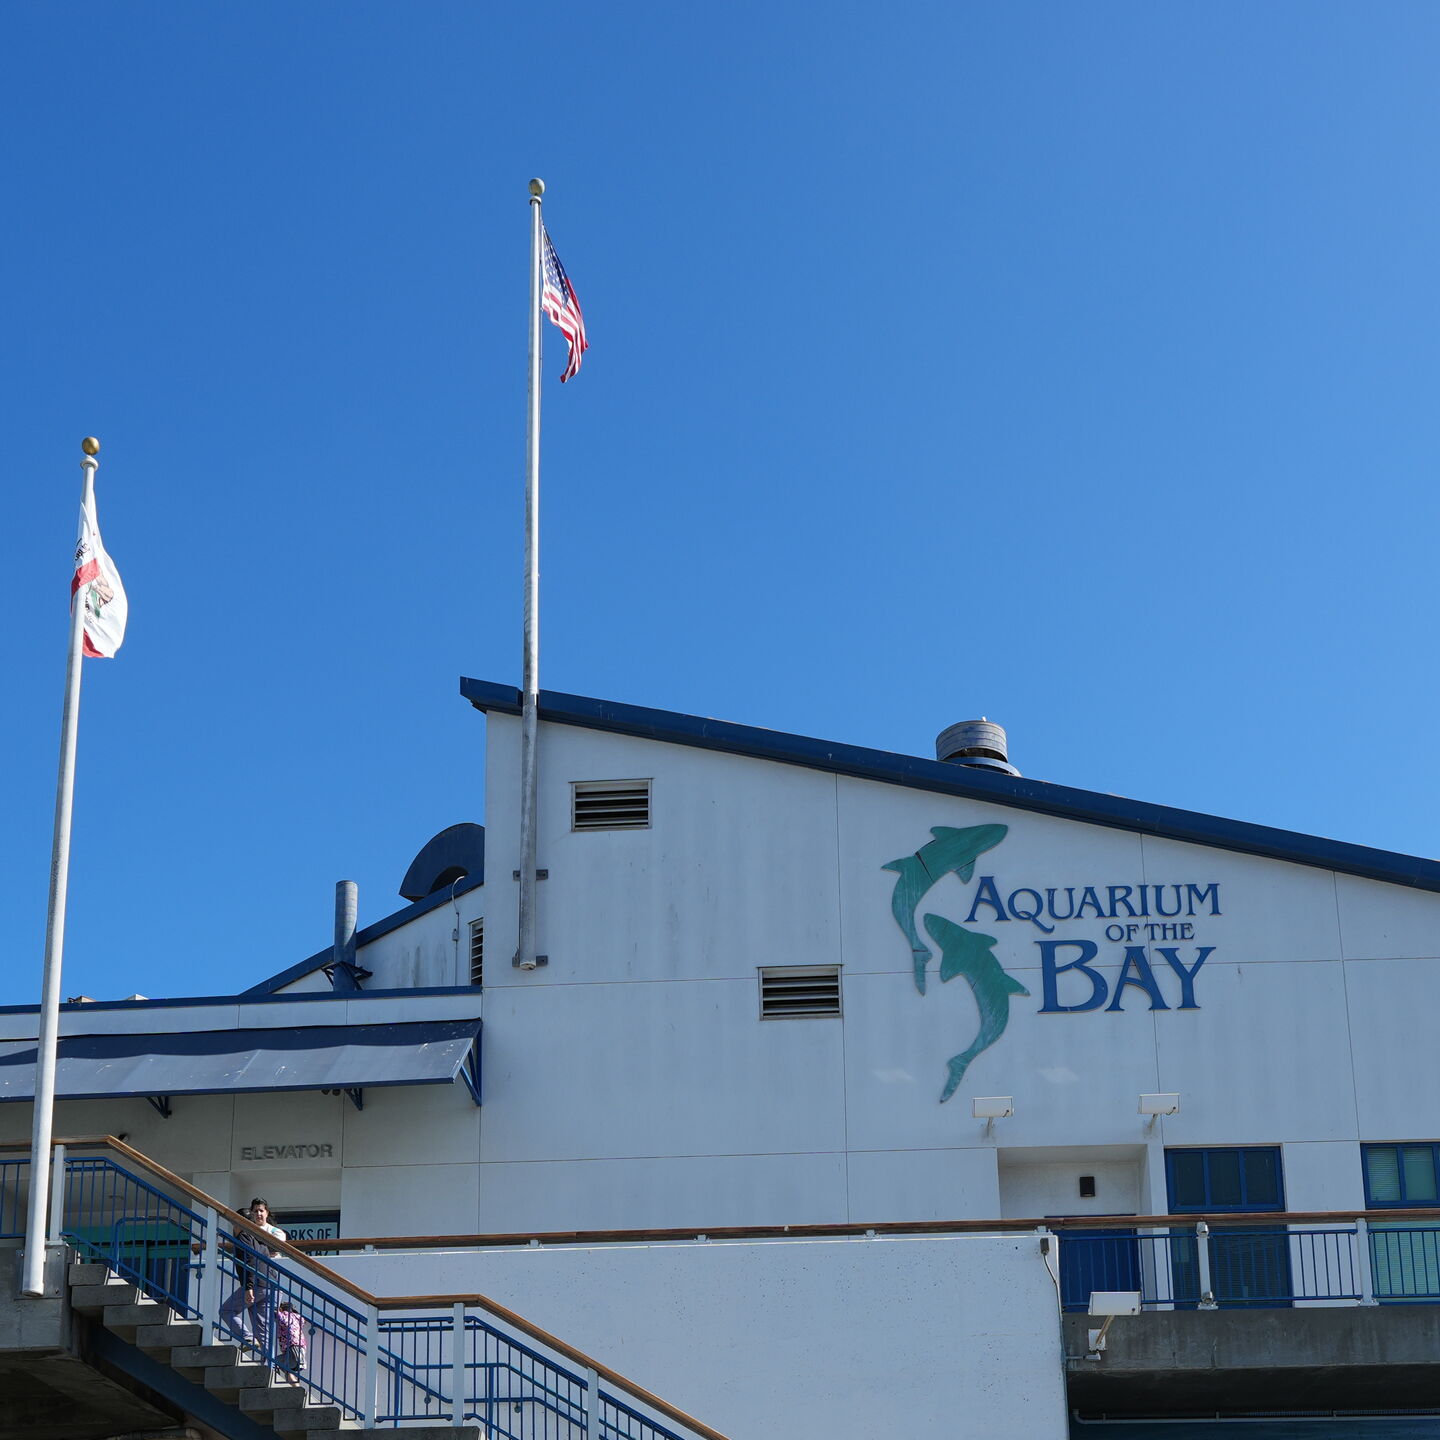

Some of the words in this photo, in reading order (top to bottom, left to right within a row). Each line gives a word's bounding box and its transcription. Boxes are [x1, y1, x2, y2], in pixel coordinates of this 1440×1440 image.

[964, 875, 1222, 933] AQUARIUM
[1105, 923, 1140, 942] OF
[1144, 922, 1195, 942] THE
[1033, 939, 1217, 1014] BAY
[241, 1143, 333, 1161] ELEVATOR
